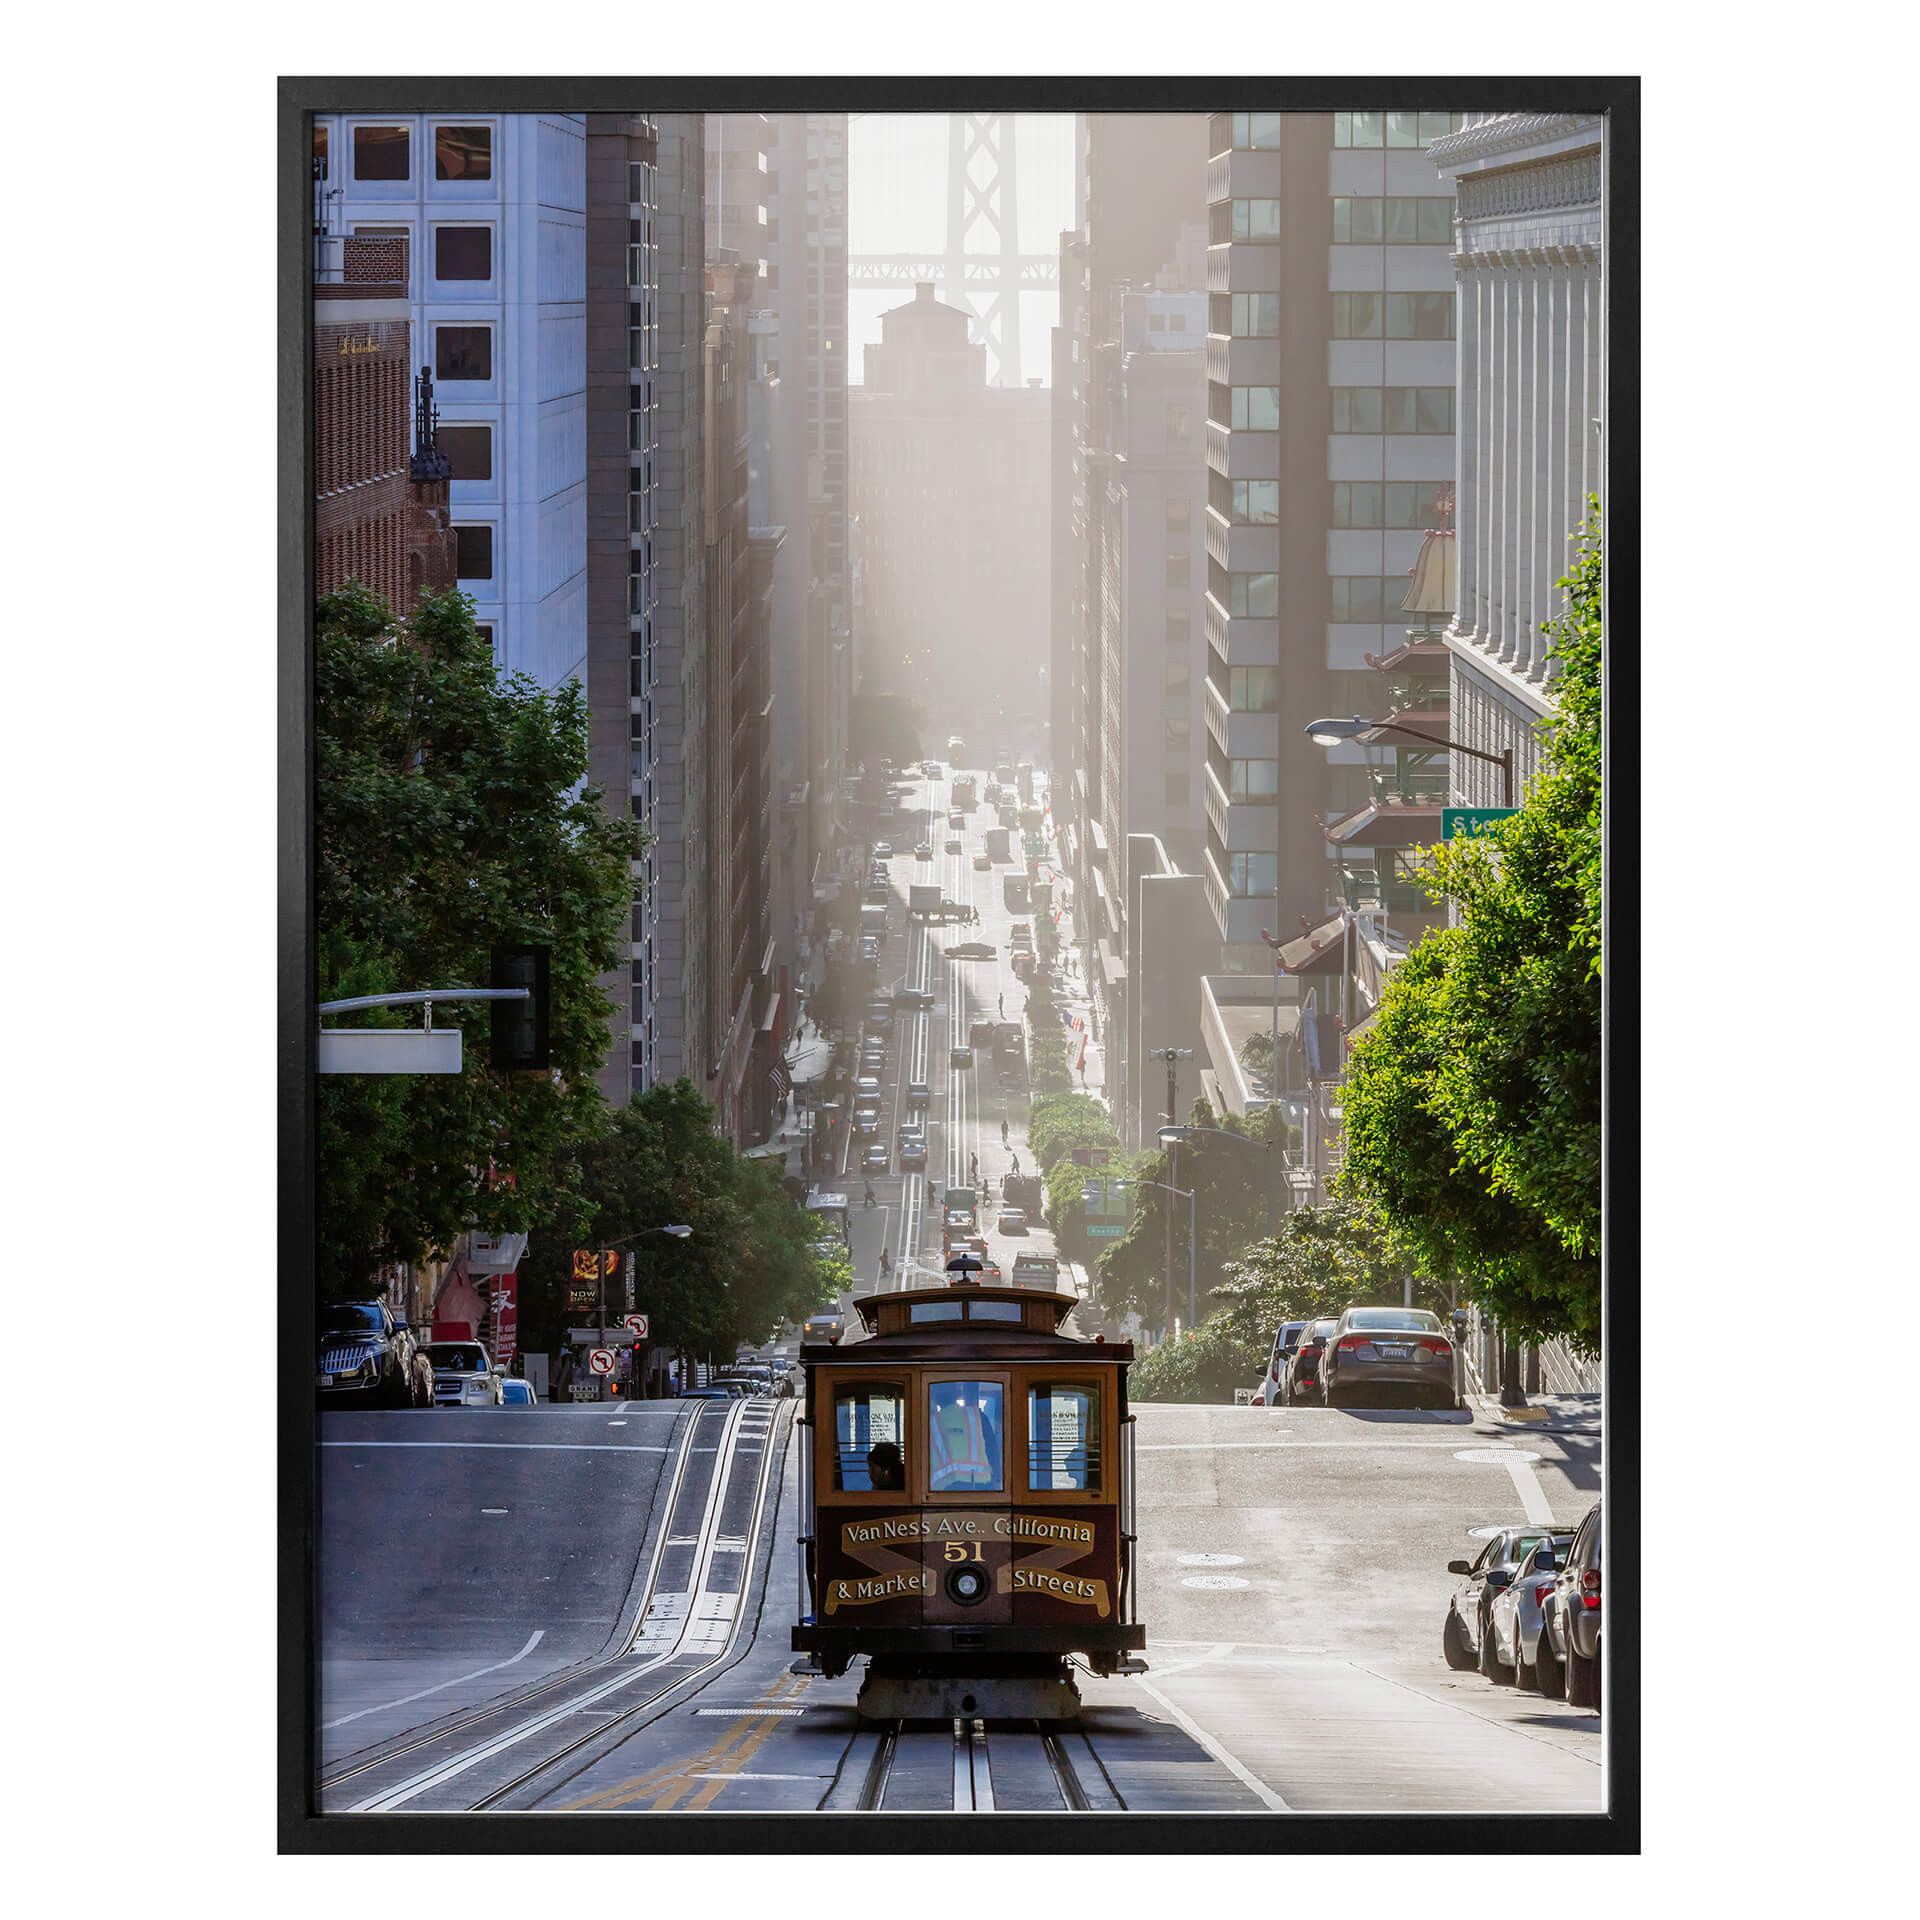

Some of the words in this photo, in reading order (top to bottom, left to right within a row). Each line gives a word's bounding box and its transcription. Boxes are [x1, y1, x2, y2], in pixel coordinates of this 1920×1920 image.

[847, 1525, 881, 1542] Van
[883, 1520, 931, 1539] Ness
[993, 1517, 1091, 1542] California
[943, 1541, 986, 1562] 51
[838, 1582, 852, 1599] &
[857, 1572, 928, 1599] Market
[1014, 1570, 1096, 1597] Streets
